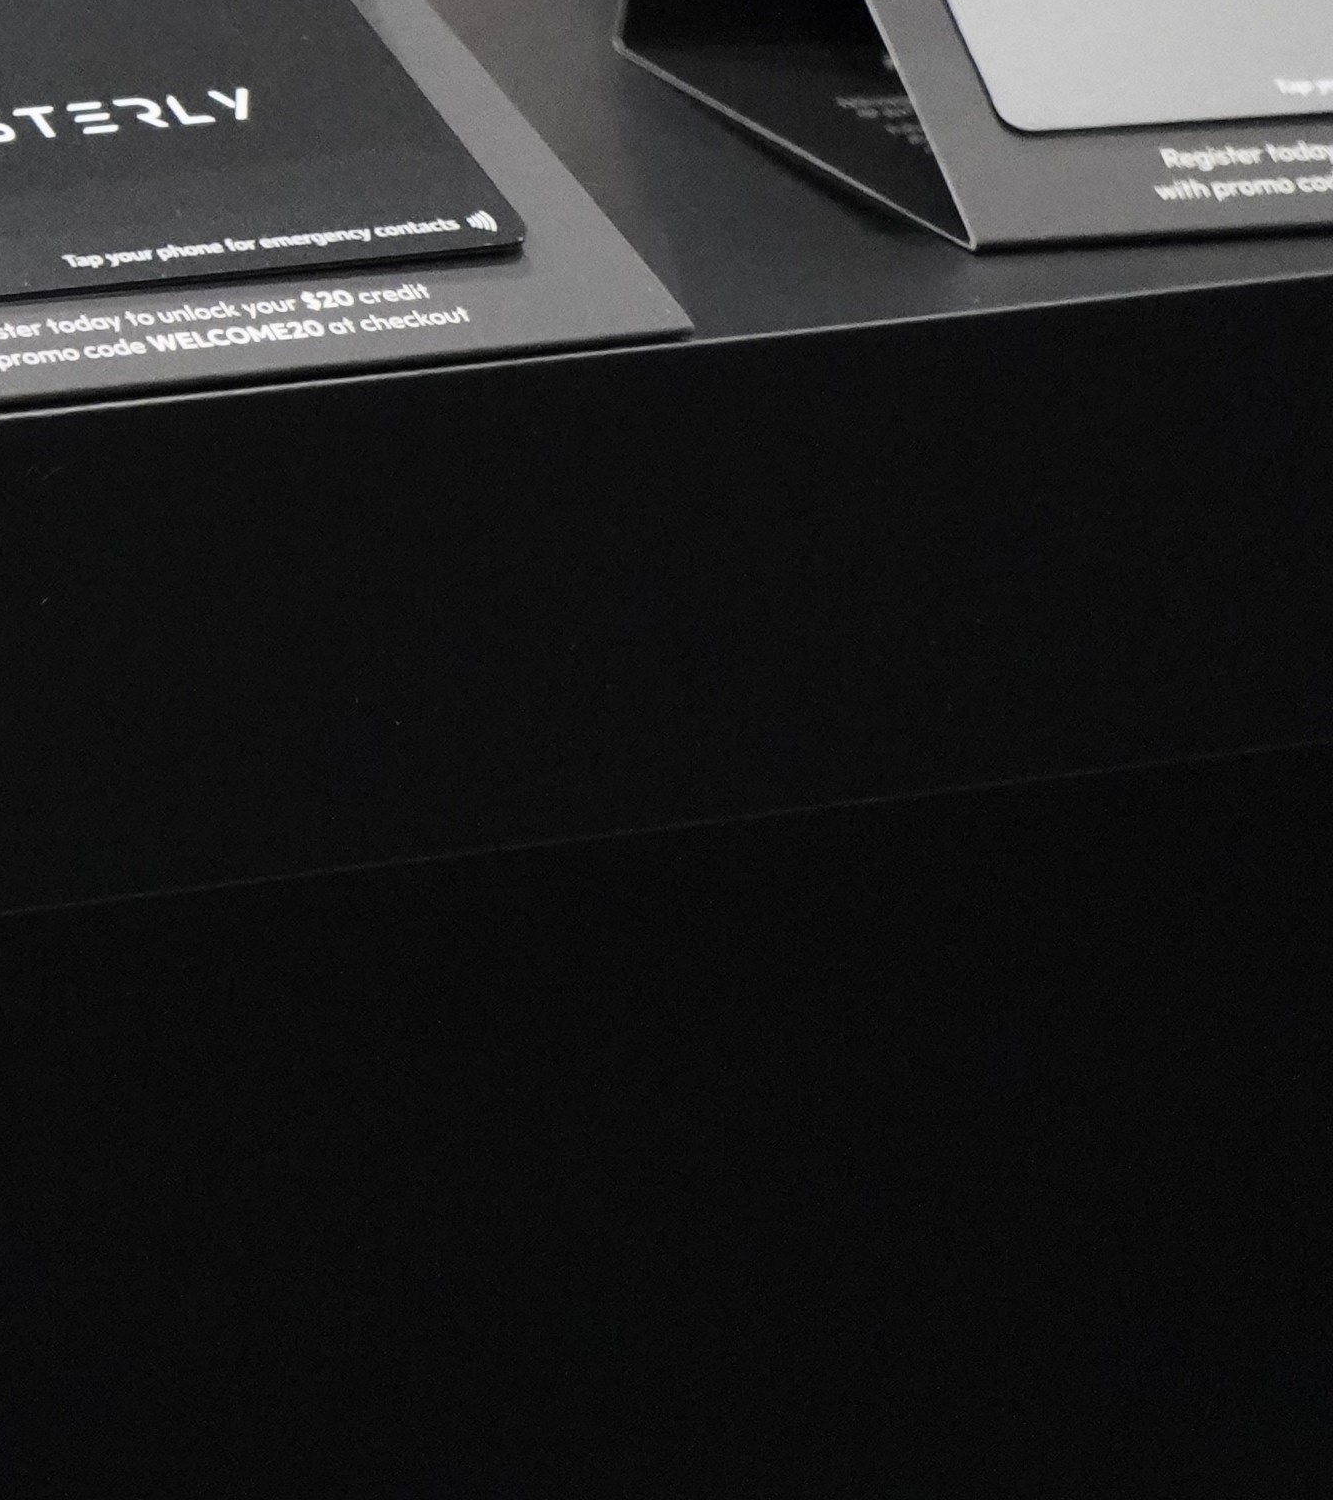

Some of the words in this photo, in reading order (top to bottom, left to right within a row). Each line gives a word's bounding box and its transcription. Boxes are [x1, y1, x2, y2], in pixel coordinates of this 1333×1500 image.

[62, 254, 104, 268] Tap
[105, 249, 152, 267] your
[156, 243, 224, 261] phone
[224, 238, 255, 251] for
[259, 228, 371, 248] emergency
[374, 218, 460, 237] contacts
[46, 315, 120, 334] today
[125, 311, 155, 326] to
[157, 301, 241, 323] unlock
[241, 299, 296, 319] your
[301, 290, 354, 311] $20
[358, 284, 430, 304] credit
[84, 338, 147, 358] code
[146, 320, 325, 352] WELCOME20
[329, 318, 355, 334] at
[360, 307, 470, 331] checkout
